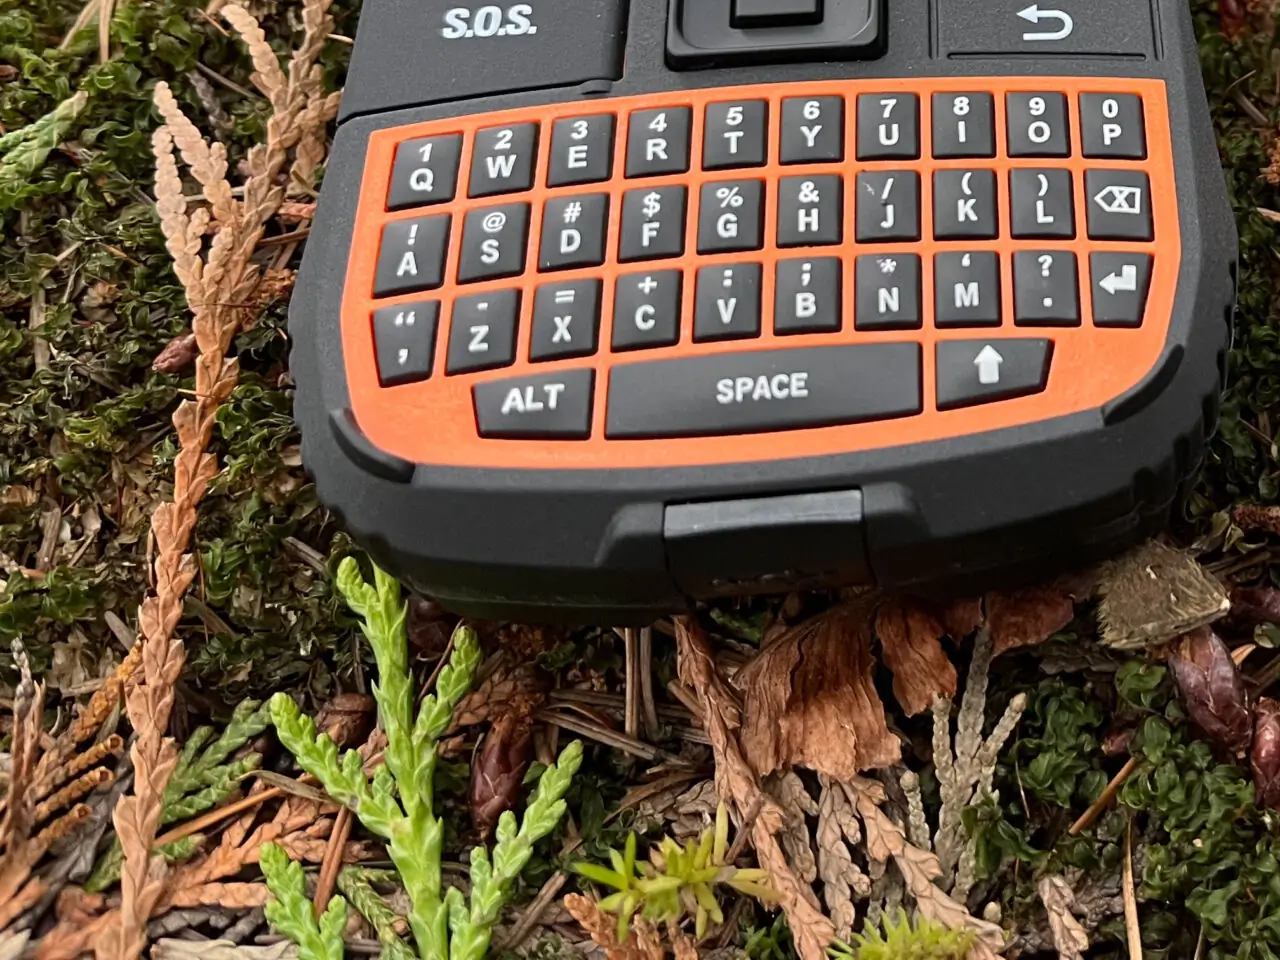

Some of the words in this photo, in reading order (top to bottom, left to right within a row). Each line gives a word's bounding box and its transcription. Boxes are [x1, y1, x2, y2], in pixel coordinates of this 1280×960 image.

[442, 3, 537, 39] S.O.S.
[726, 106, 743, 125] 5
[803, 101, 820, 120] 6
[880, 99, 897, 119] 7
[953, 96, 969, 115] 8
[1029, 97, 1045, 115] 9
[1102, 99, 1118, 118] 0
[570, 120, 589, 139] 3
[649, 113, 668, 132] 4
[958, 121, 965, 142] I
[1028, 121, 1050, 143] O
[494, 130, 514, 150] 2
[724, 131, 744, 153] T
[801, 125, 822, 147] Y
[879, 124, 899, 145] U
[1103, 124, 1122, 145] P
[418, 143, 432, 162] 1
[568, 145, 588, 168] E
[646, 139, 668, 160] R
[486, 155, 516, 179] W
[410, 168, 434, 191] Q
[716, 187, 744, 208] %
[799, 181, 819, 203] &
[564, 202, 582, 223] #
[642, 192, 661, 216] $
[958, 199, 978, 222] K
[1036, 201, 1054, 223] L
[483, 212, 506, 232] @
[717, 213, 738, 238] G
[798, 208, 819, 232] H
[880, 204, 894, 228] J
[408, 225, 418, 245] !
[560, 229, 581, 254] D
[642, 222, 660, 246] F
[480, 240, 500, 264] S
[397, 252, 417, 276] A
[1038, 255, 1053, 277] ?
[638, 276, 657, 294] +
[954, 282, 979, 308] M
[717, 298, 736, 324] V
[795, 293, 816, 318] B
[878, 287, 899, 313] N
[635, 305, 655, 330] C
[469, 325, 489, 351] Z
[552, 316, 572, 342] X
[501, 384, 565, 414] ALT
[716, 372, 808, 404] SPACE
